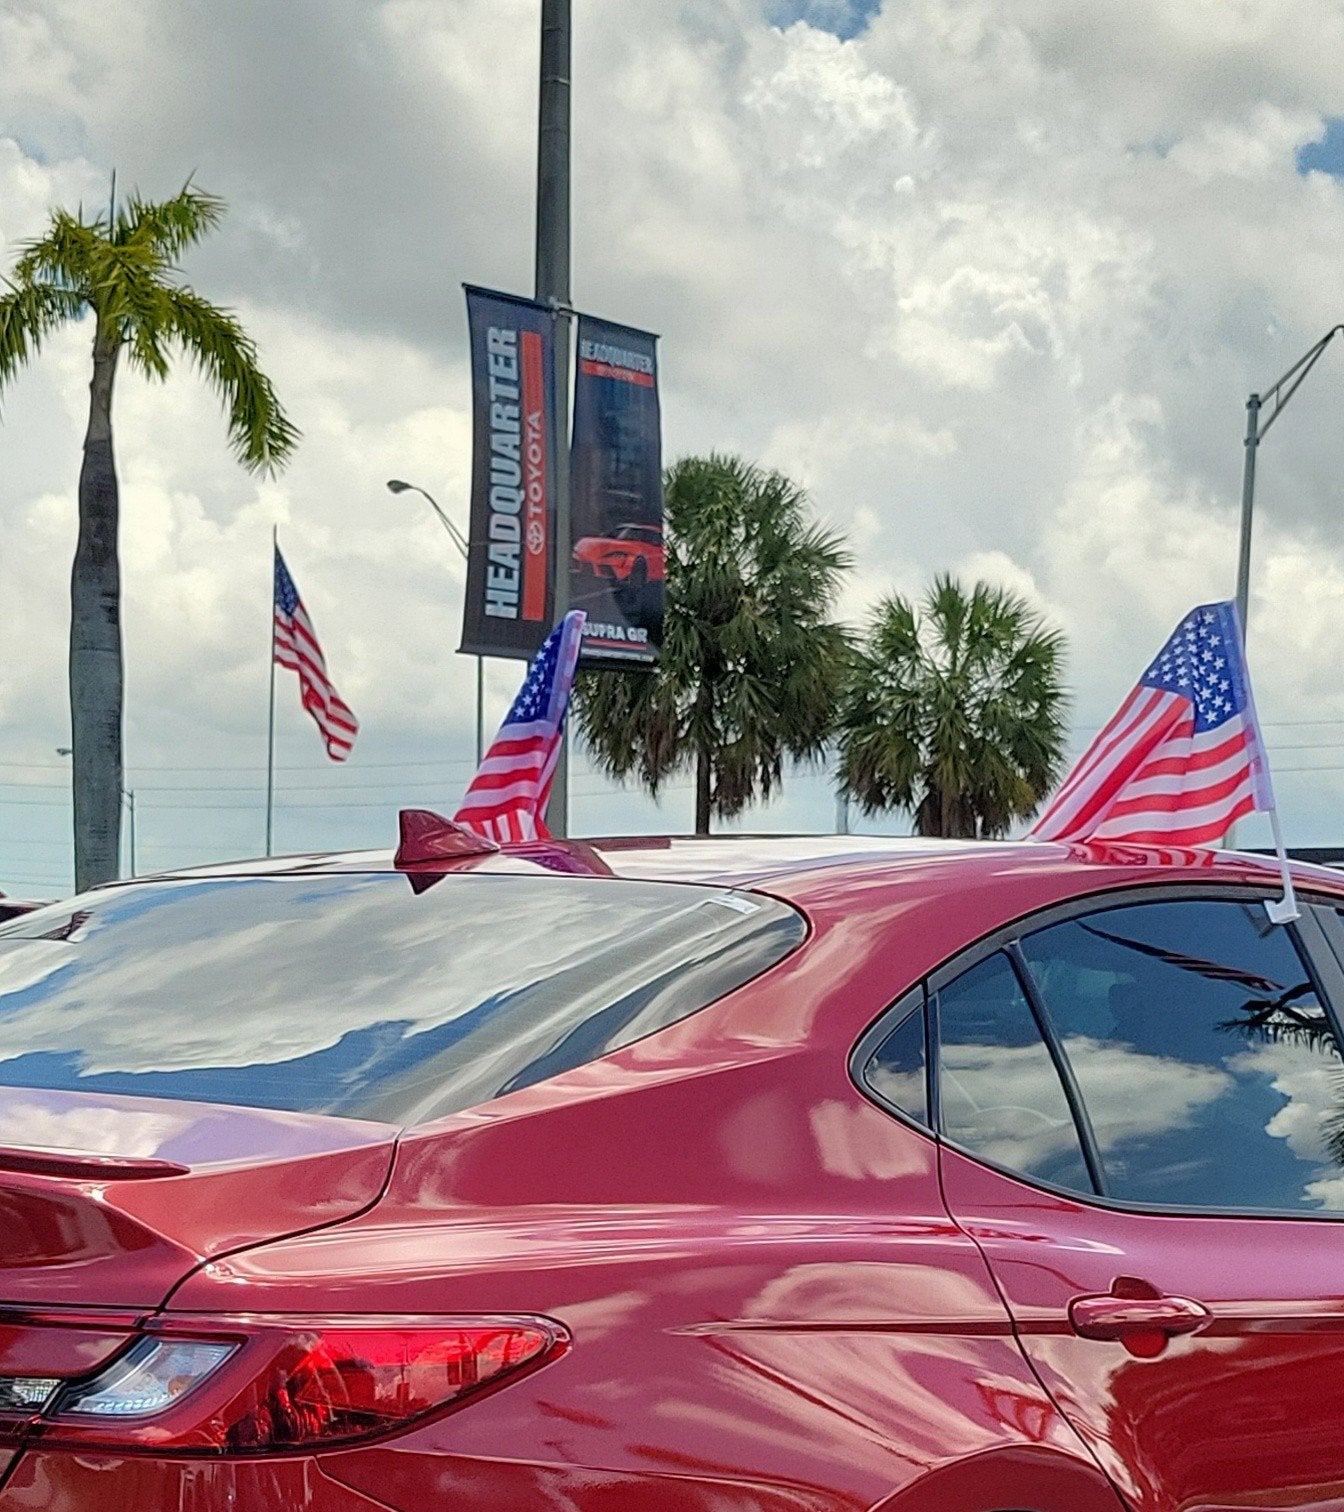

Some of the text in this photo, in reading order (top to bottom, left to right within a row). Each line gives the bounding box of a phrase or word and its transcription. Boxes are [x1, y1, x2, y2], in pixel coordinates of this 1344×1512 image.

[485, 327, 525, 619] HEADQUARTER
[528, 411, 544, 518] TOYOTA
[582, 621, 649, 643] SUPRA GR
